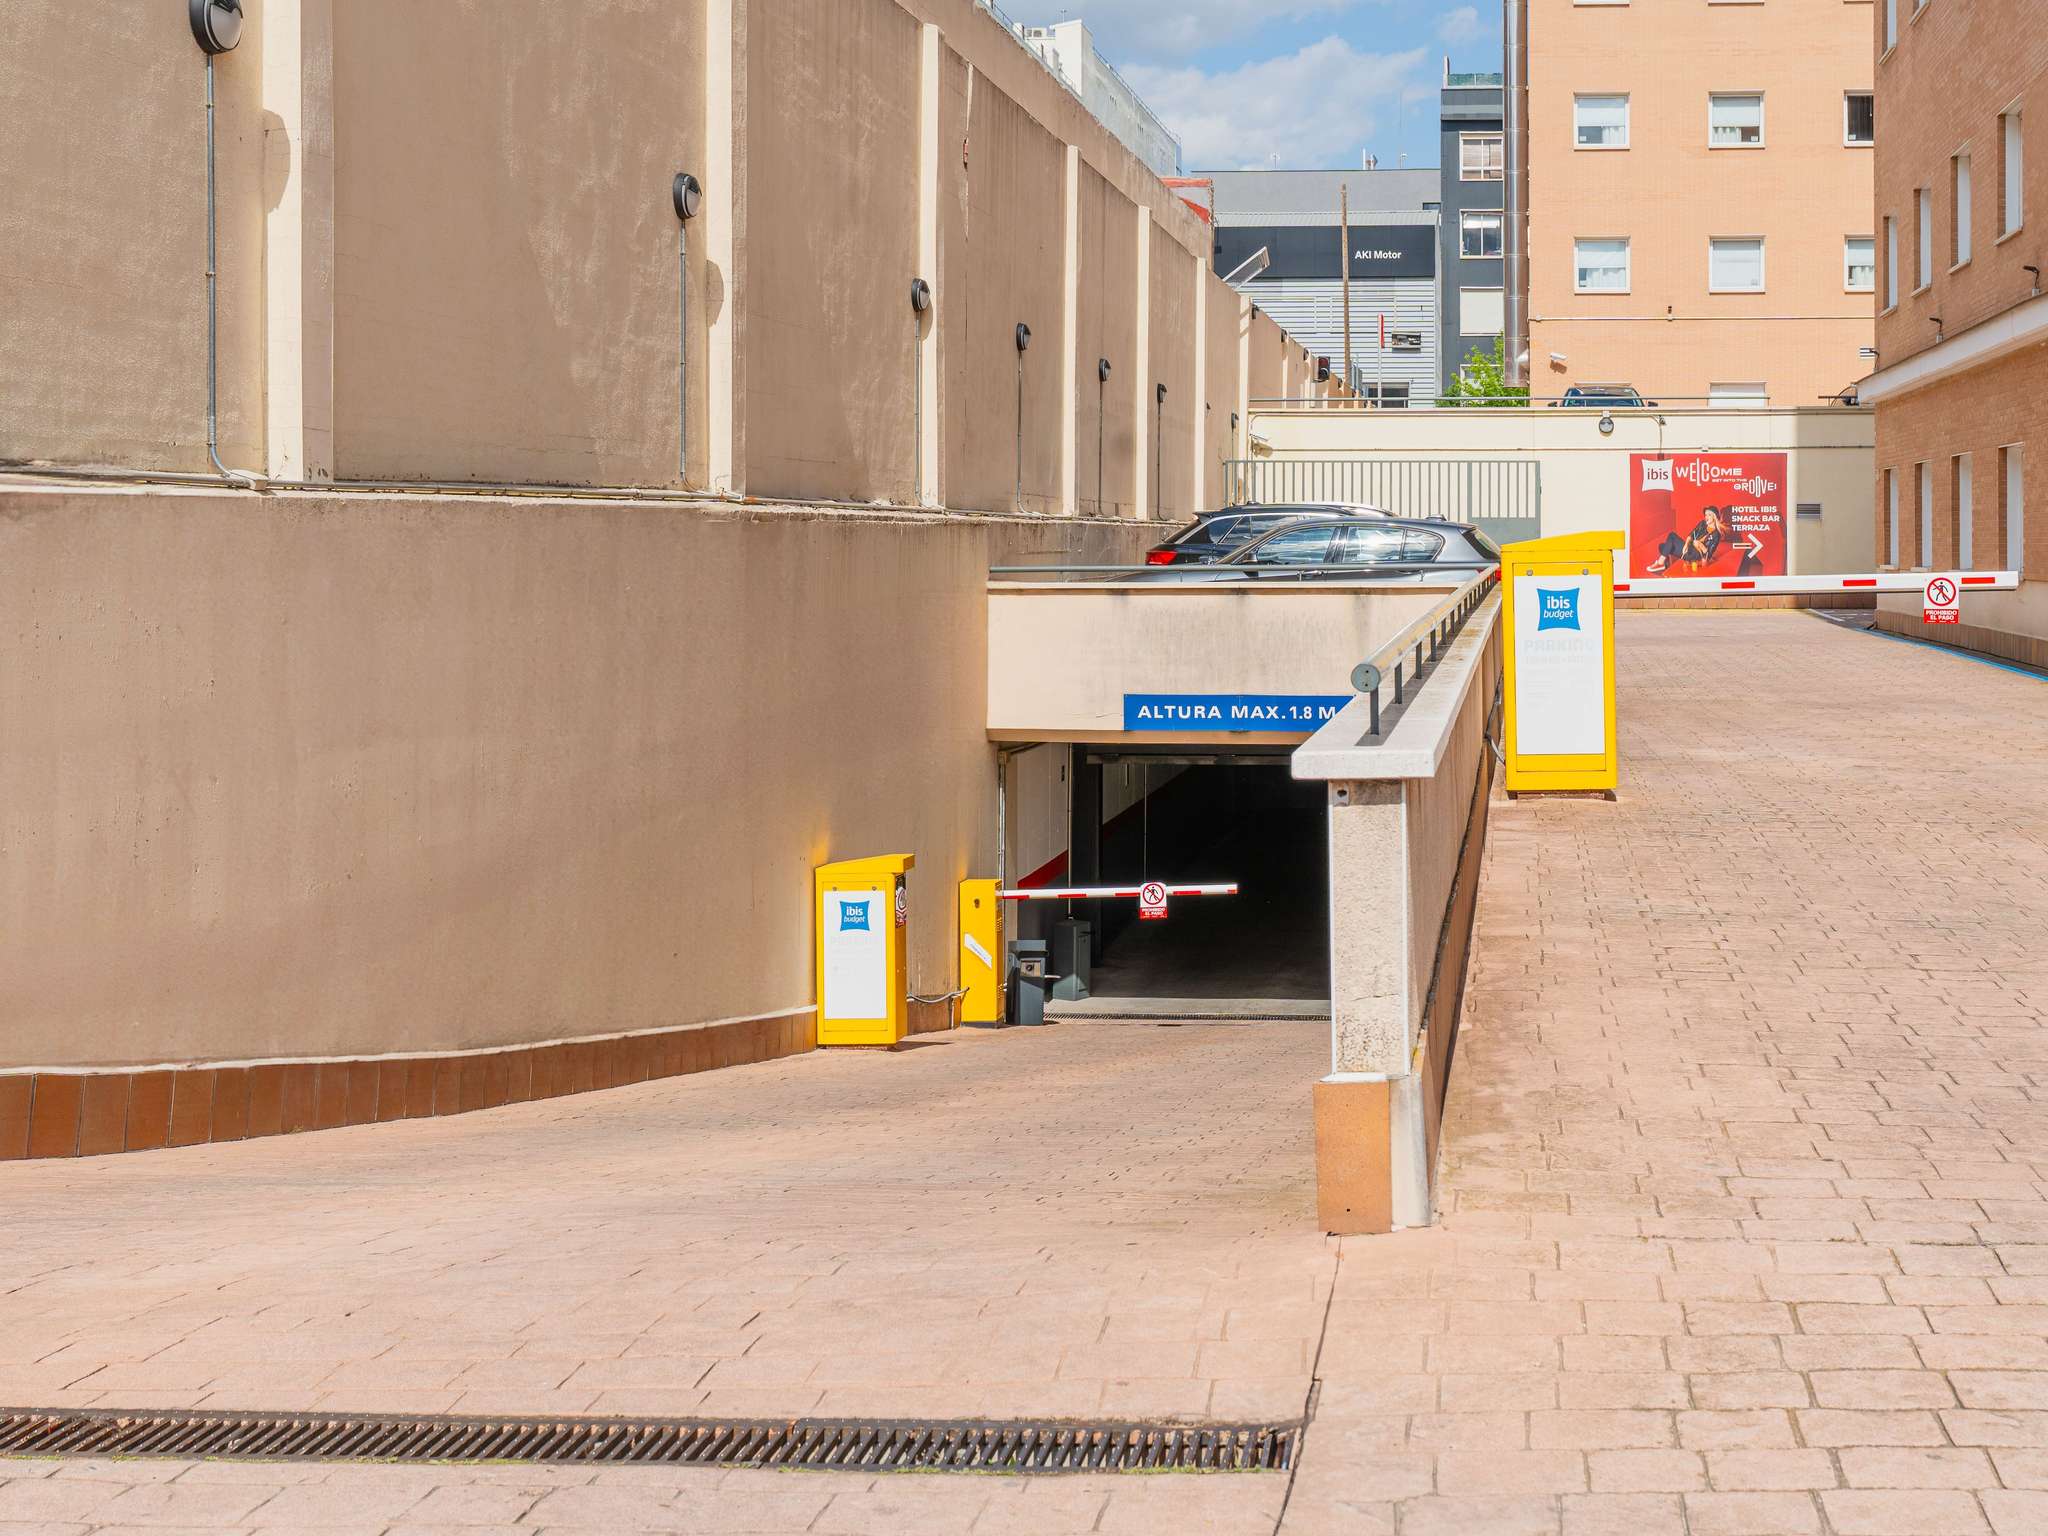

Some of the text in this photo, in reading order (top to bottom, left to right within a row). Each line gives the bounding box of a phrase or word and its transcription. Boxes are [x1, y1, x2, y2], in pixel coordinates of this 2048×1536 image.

[1355, 250, 1402, 259] AKI Motor
[1647, 468, 1669, 481] ibis
[1676, 458, 1742, 487] WELCOME
[1732, 524, 1770, 532] TERRAZA
[1546, 595, 1571, 609] ibis
[1543, 609, 1574, 620] budget
[1137, 705, 1222, 719] ALTURA
[846, 906, 864, 916] ibis
[843, 915, 865, 924] budget
